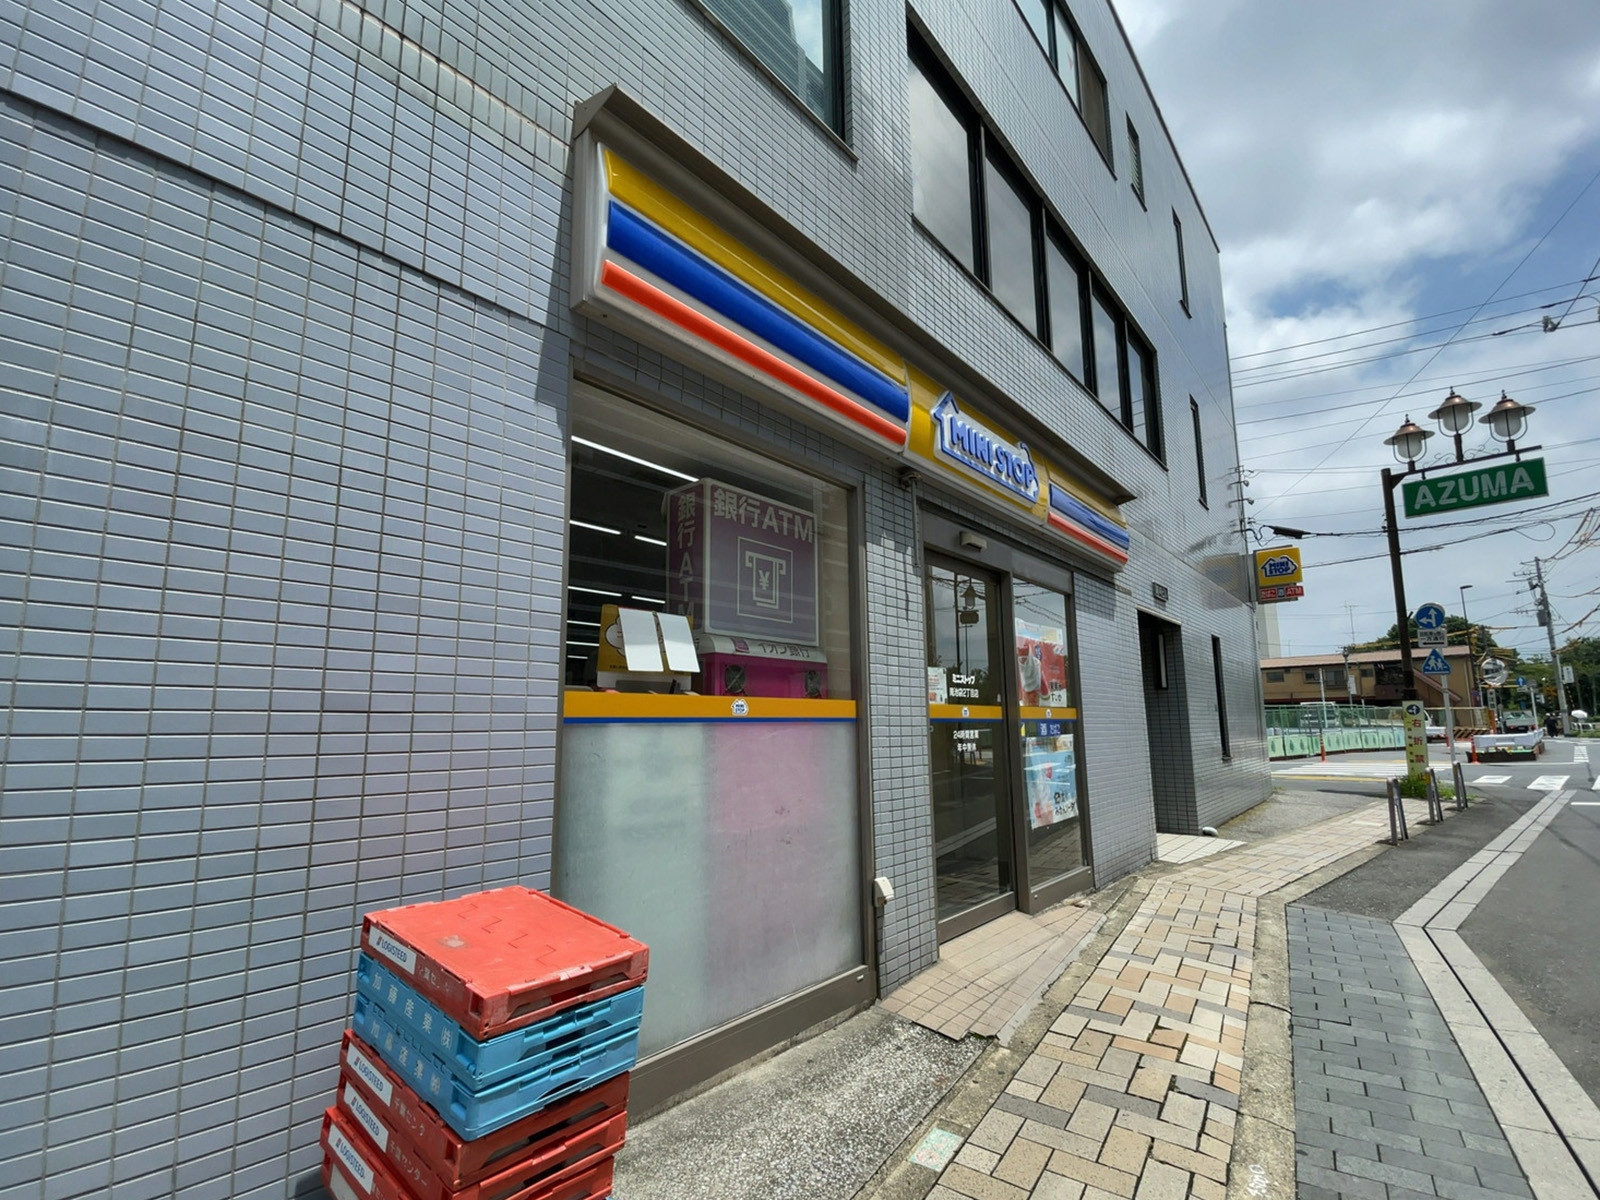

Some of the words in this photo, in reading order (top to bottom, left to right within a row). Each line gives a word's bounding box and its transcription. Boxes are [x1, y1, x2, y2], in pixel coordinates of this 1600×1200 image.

[950, 415, 994, 467] MINI
[994, 444, 1035, 489] STOP
[1414, 467, 1535, 510] AZUMA
[713, 488, 813, 544] 銀行ATM
[1269, 566, 1290, 575] STOP
[1287, 586, 1303, 596] ATM
[381, 938, 408, 963] LOGISTEED
[358, 1060, 384, 1092] LOGISTEED
[355, 1102, 380, 1137] LOGISTEED
[339, 1141, 365, 1179] LOGISTEED
